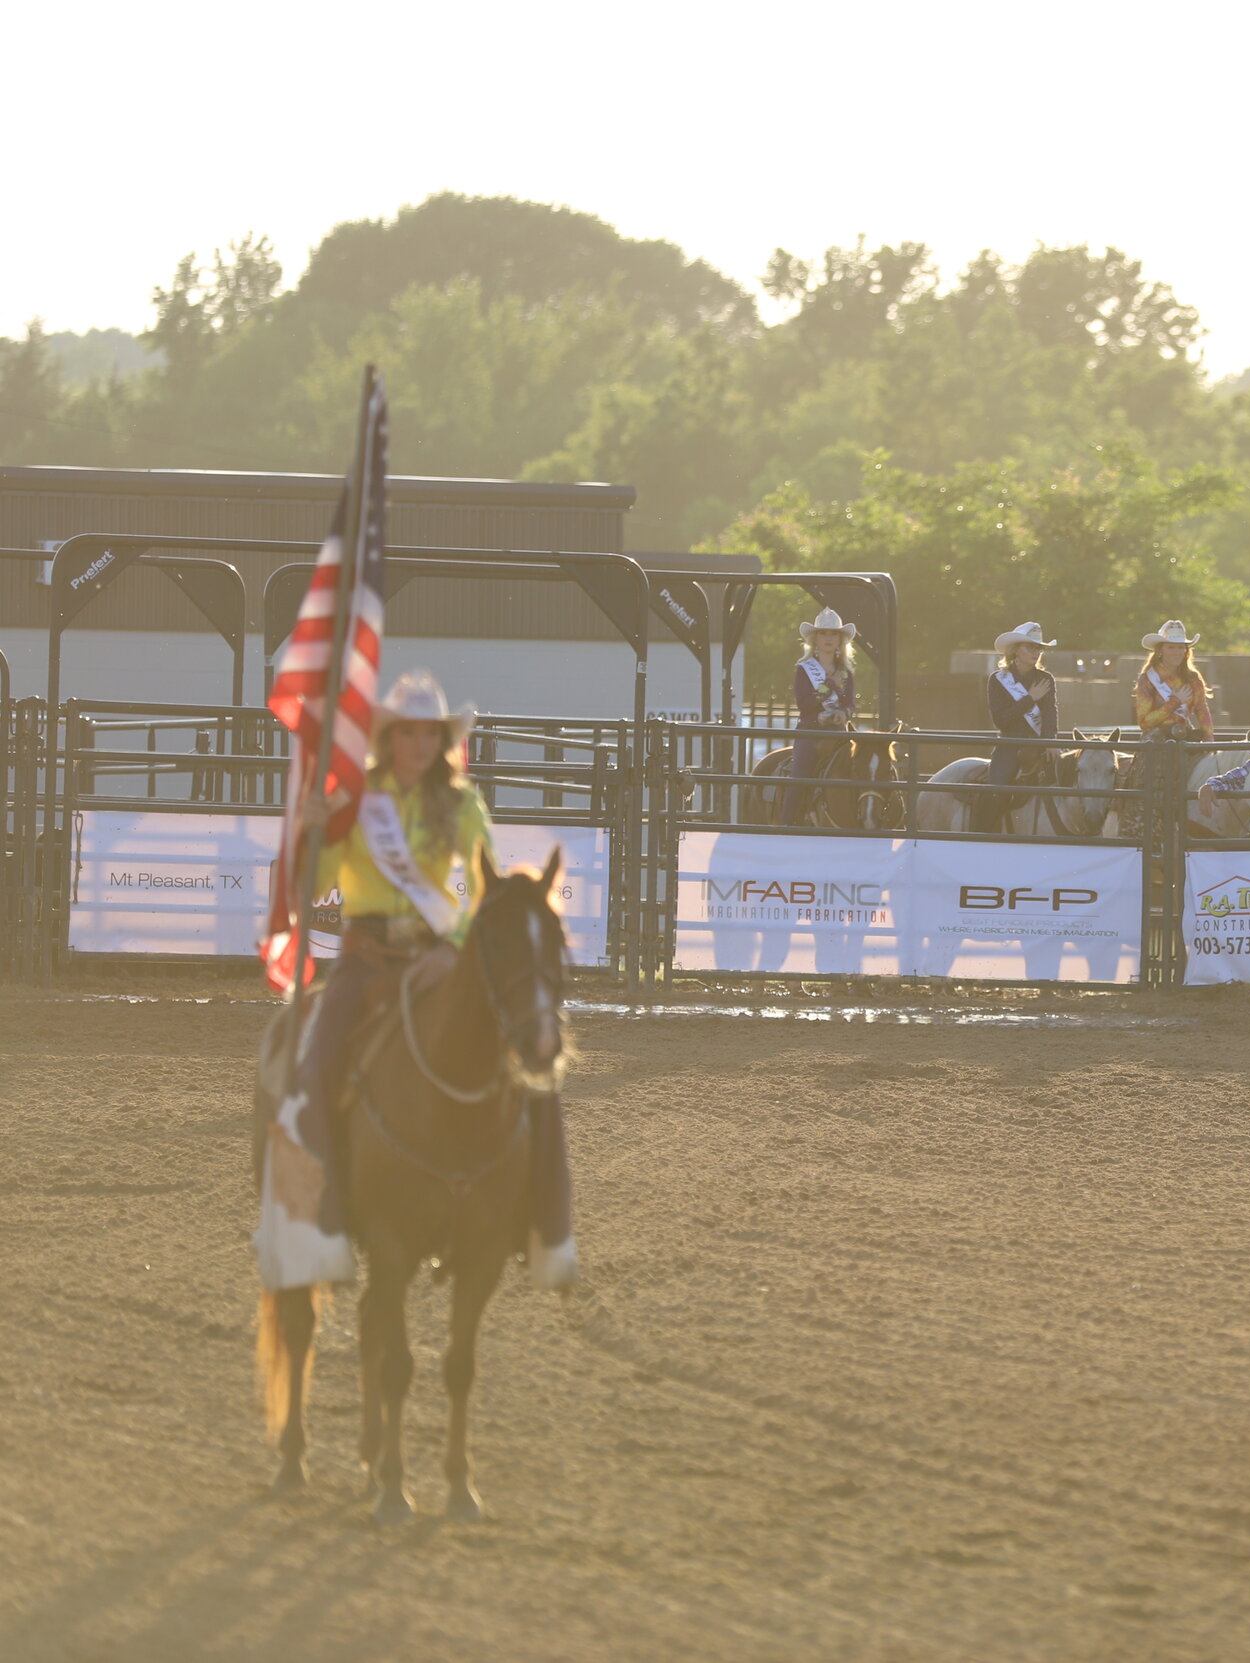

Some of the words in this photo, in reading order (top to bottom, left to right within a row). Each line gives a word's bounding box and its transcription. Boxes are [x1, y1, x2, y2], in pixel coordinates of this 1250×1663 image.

[70, 550, 114, 590] Priefert
[110, 872, 133, 887] Mt
[138, 872, 214, 890] Pleasant,
[220, 874, 243, 889] TX
[701, 905, 790, 920] IMAGINATION
[798, 908, 887, 923] FABRICATION
[1201, 895, 1235, 917] R.A.
[973, 927, 1029, 935] FABRICATION
[1062, 929, 1119, 937] IMAGINATION
